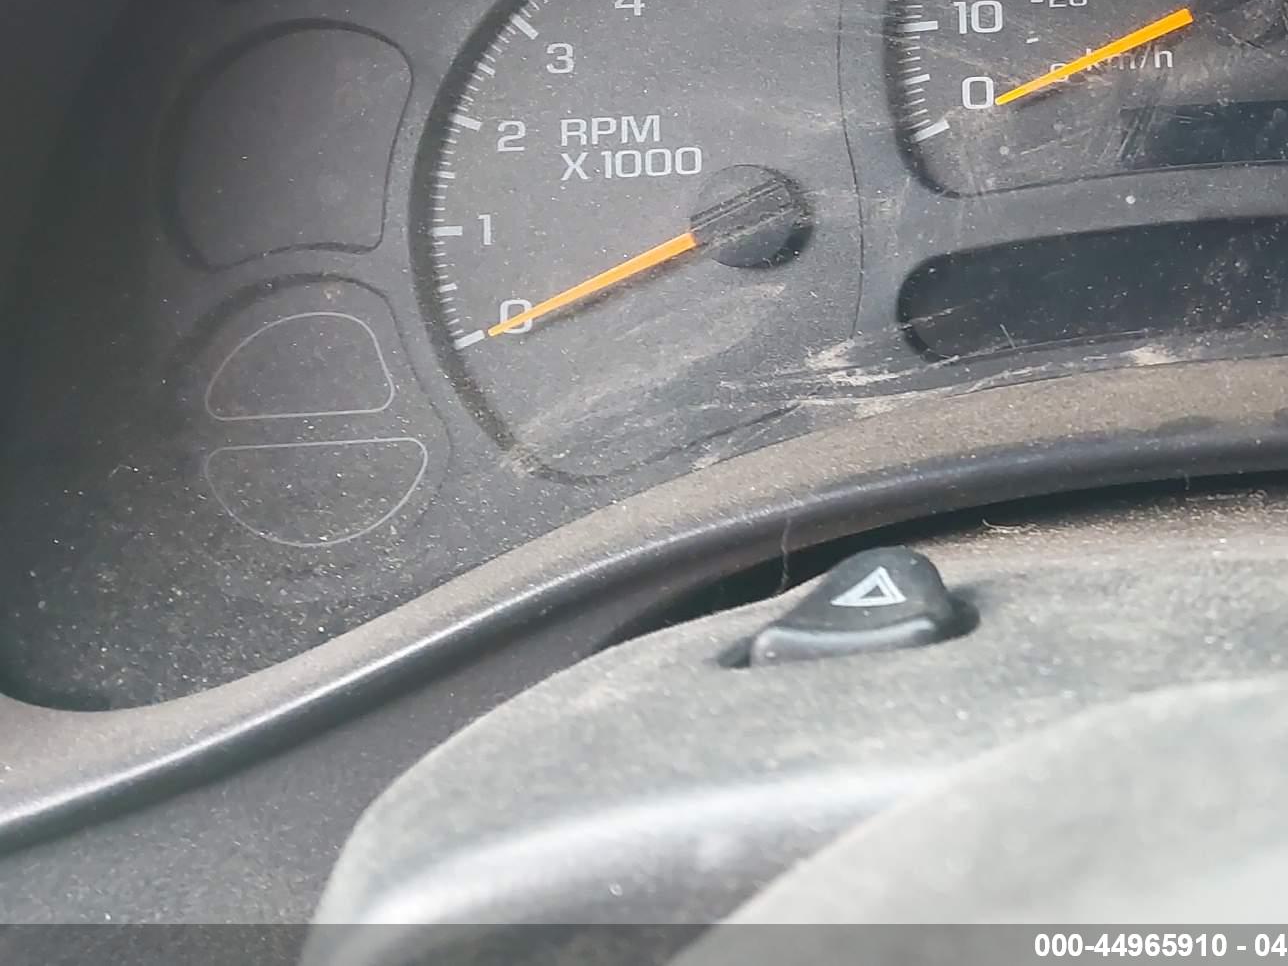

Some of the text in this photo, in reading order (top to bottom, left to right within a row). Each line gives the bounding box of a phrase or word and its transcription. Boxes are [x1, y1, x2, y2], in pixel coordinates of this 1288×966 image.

[954, 1, 1002, 34] 10
[547, 43, 574, 73] 3
[963, 77, 993, 110] 0
[498, 121, 525, 151] 2
[561, 115, 659, 146] RPM
[560, 147, 702, 181] X 1000
[478, 215, 491, 245] 1
[499, 299, 533, 334] 0
